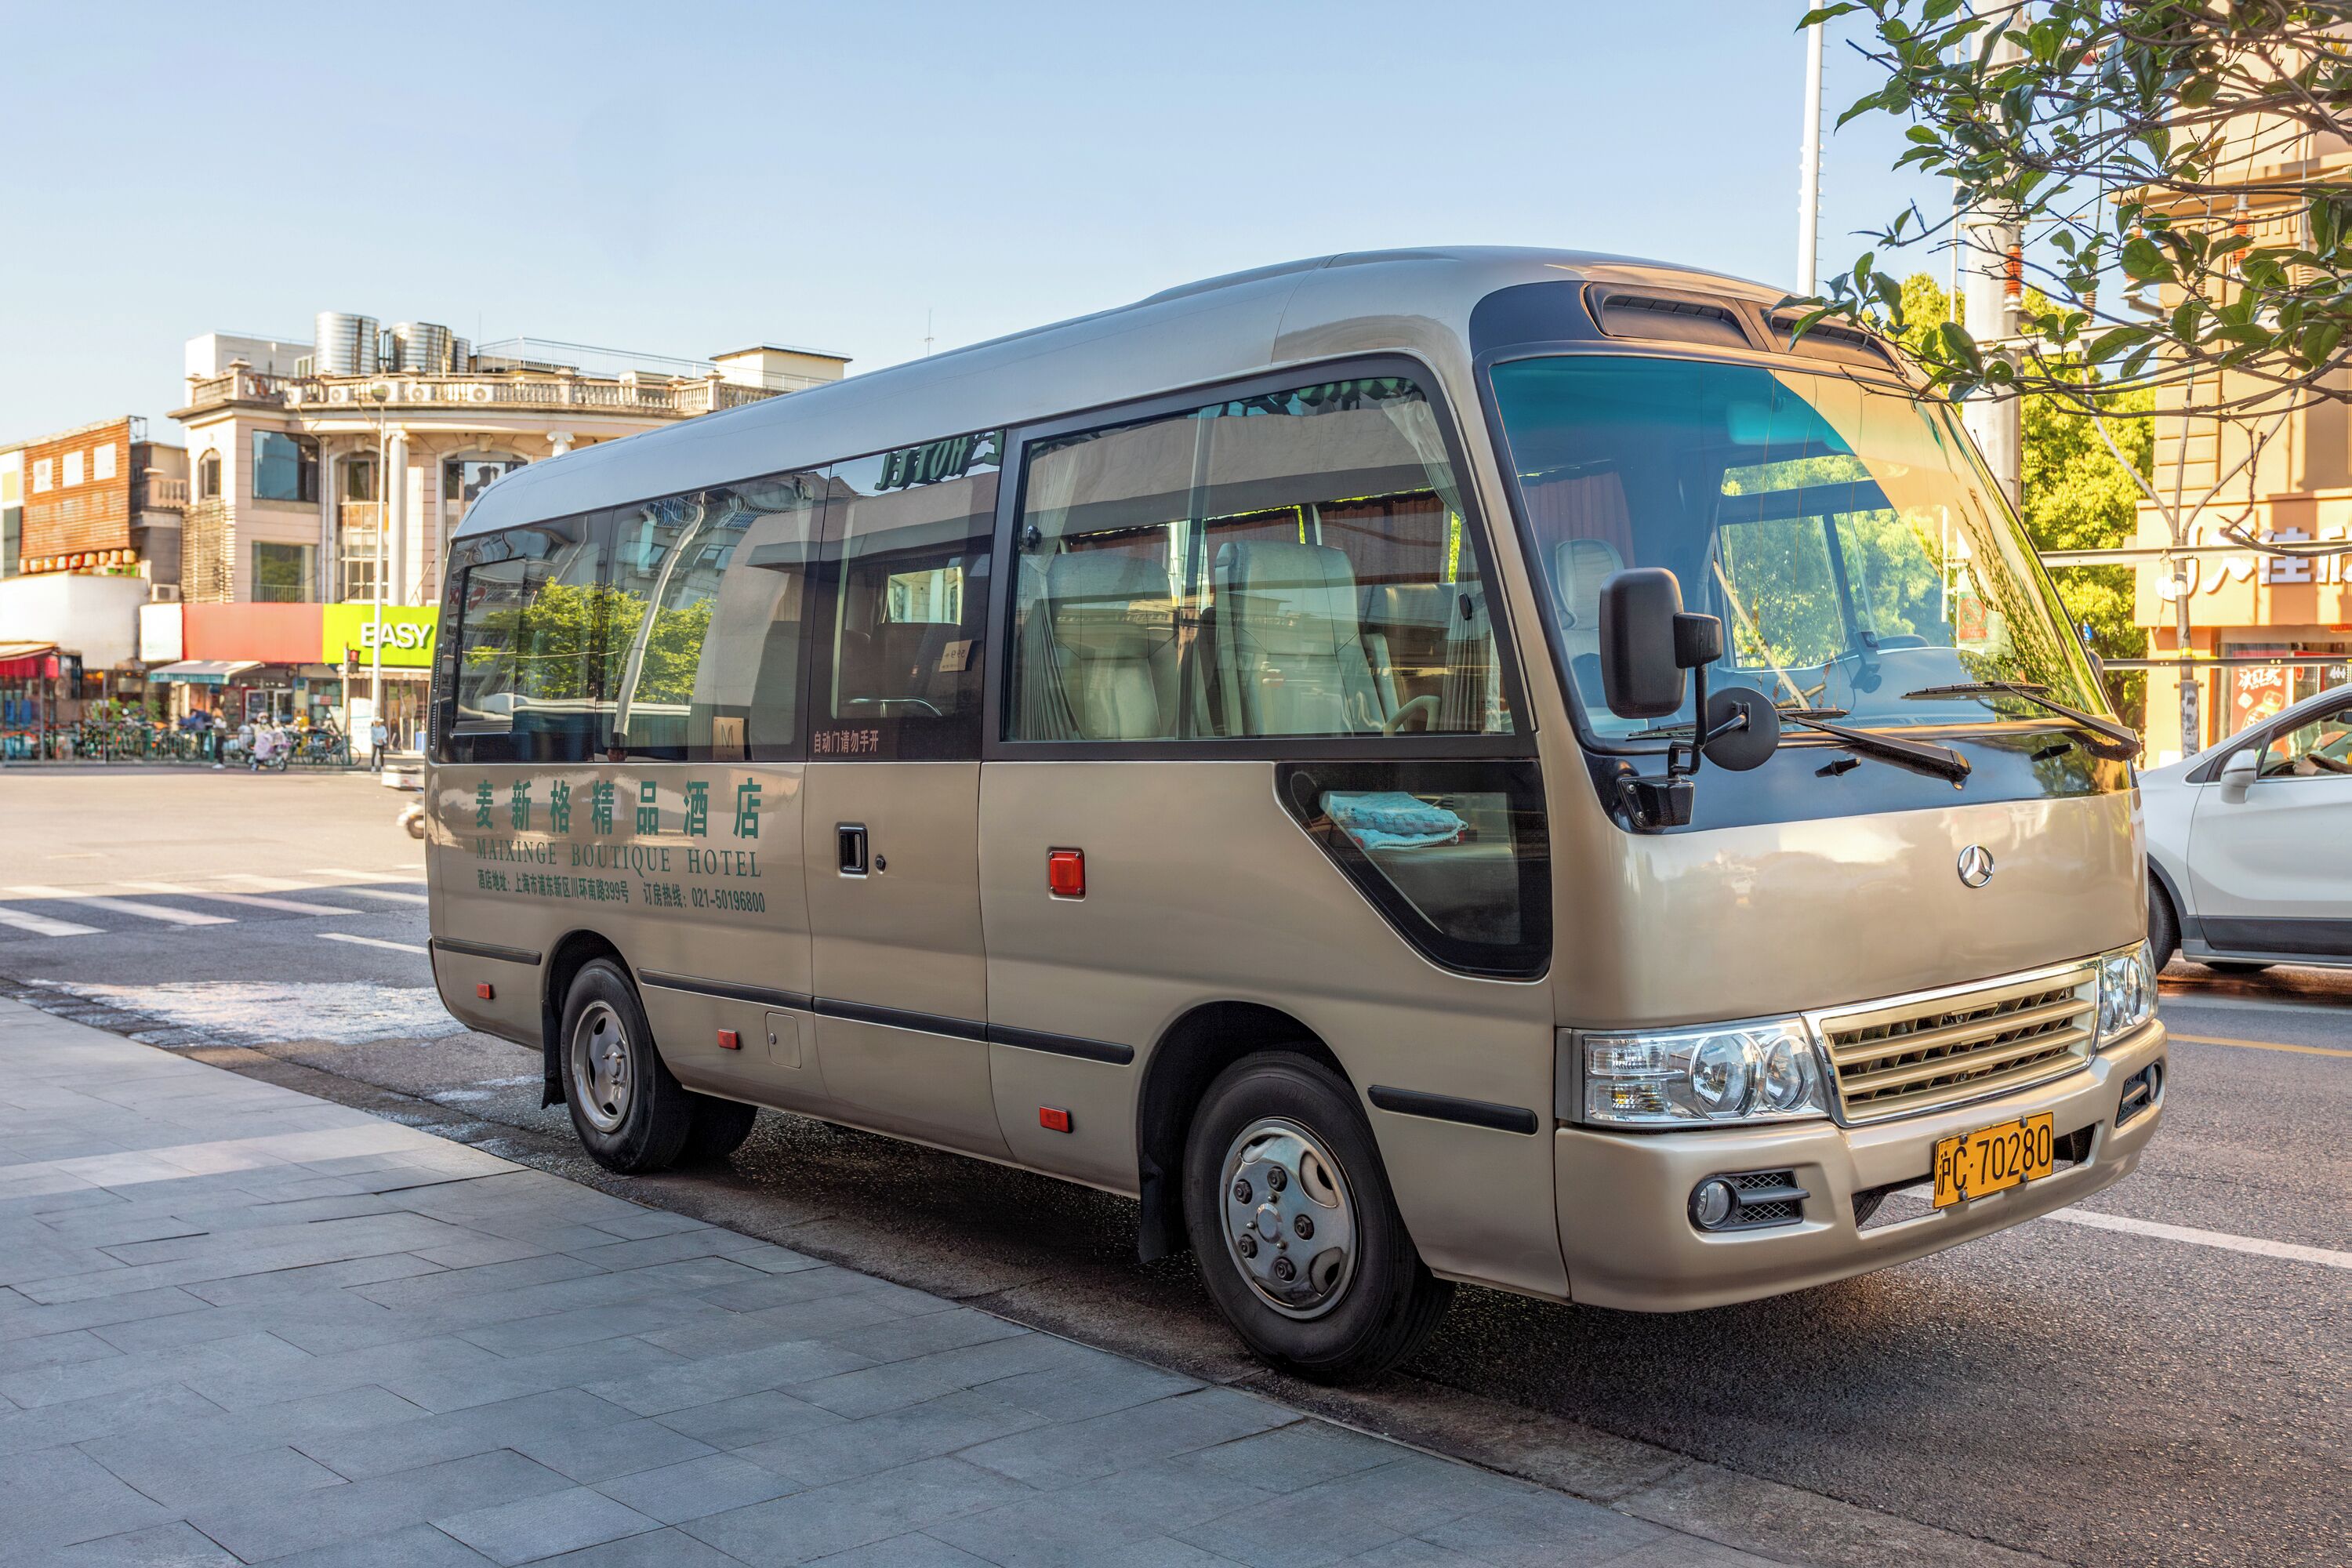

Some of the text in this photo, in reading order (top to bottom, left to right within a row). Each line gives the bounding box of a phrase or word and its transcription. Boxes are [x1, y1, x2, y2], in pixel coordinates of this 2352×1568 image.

[361, 622, 432, 648] EASY
[814, 730, 879, 753] 自动门请勿手开
[476, 777, 762, 839] 麦新格精品酒店
[476, 838, 762, 878] MAIXINGE BOUTIQUE HOTEL
